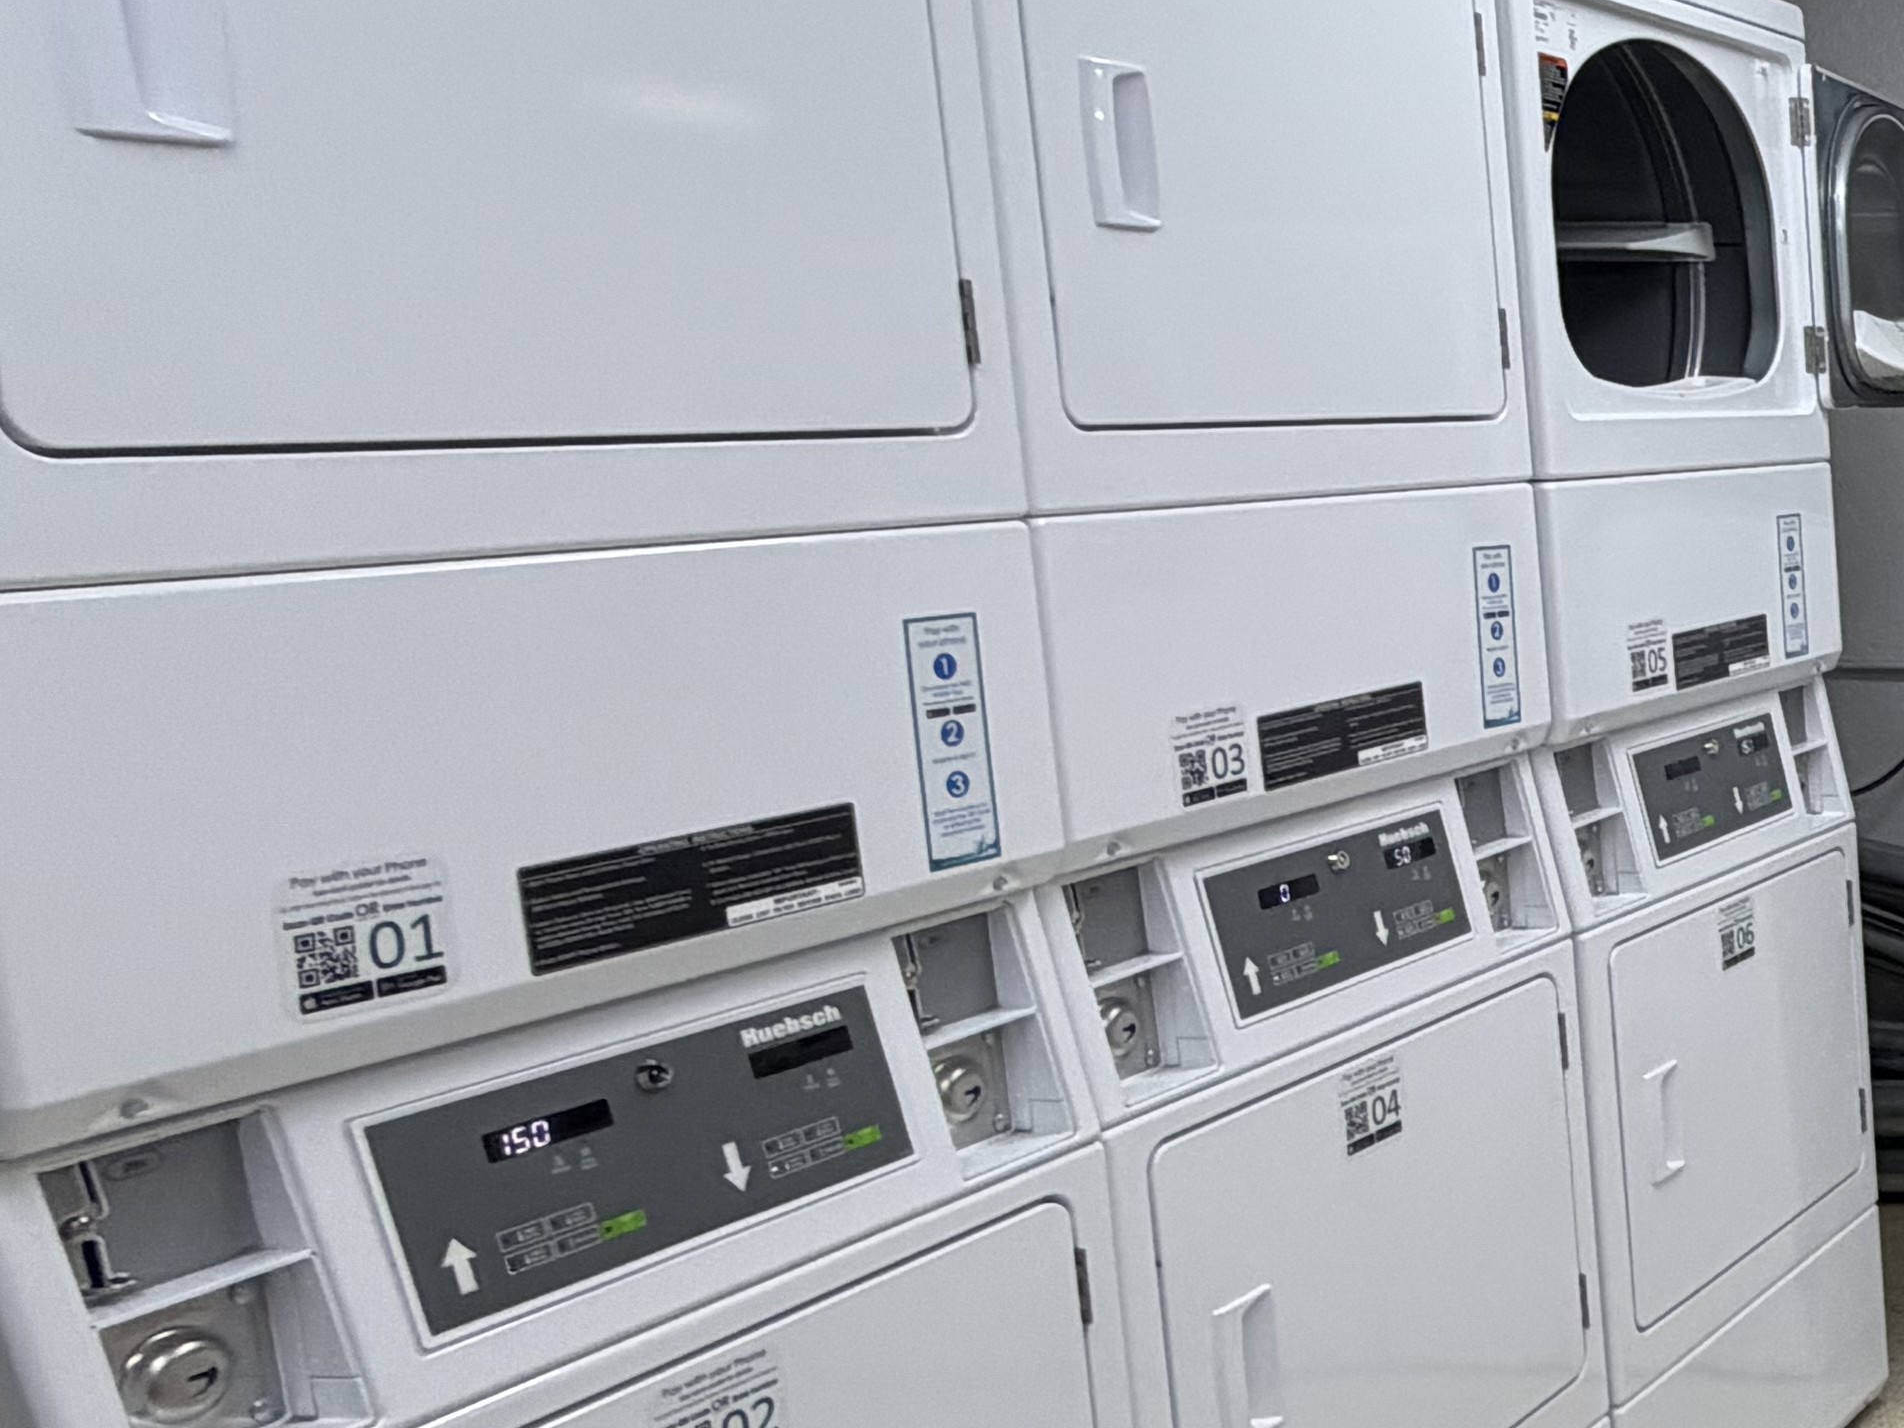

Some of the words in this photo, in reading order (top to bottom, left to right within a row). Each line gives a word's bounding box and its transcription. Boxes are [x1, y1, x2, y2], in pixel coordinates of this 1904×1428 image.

[1648, 646, 1668, 674] 05
[1211, 743, 1246, 780] 03
[355, 900, 381, 917] OR
[368, 913, 445, 970] 01
[1736, 922, 1755, 949] 06
[739, 1004, 842, 1048] Huebsch
[1371, 1088, 1402, 1125] 04
[502, 1119, 552, 1155] 150
